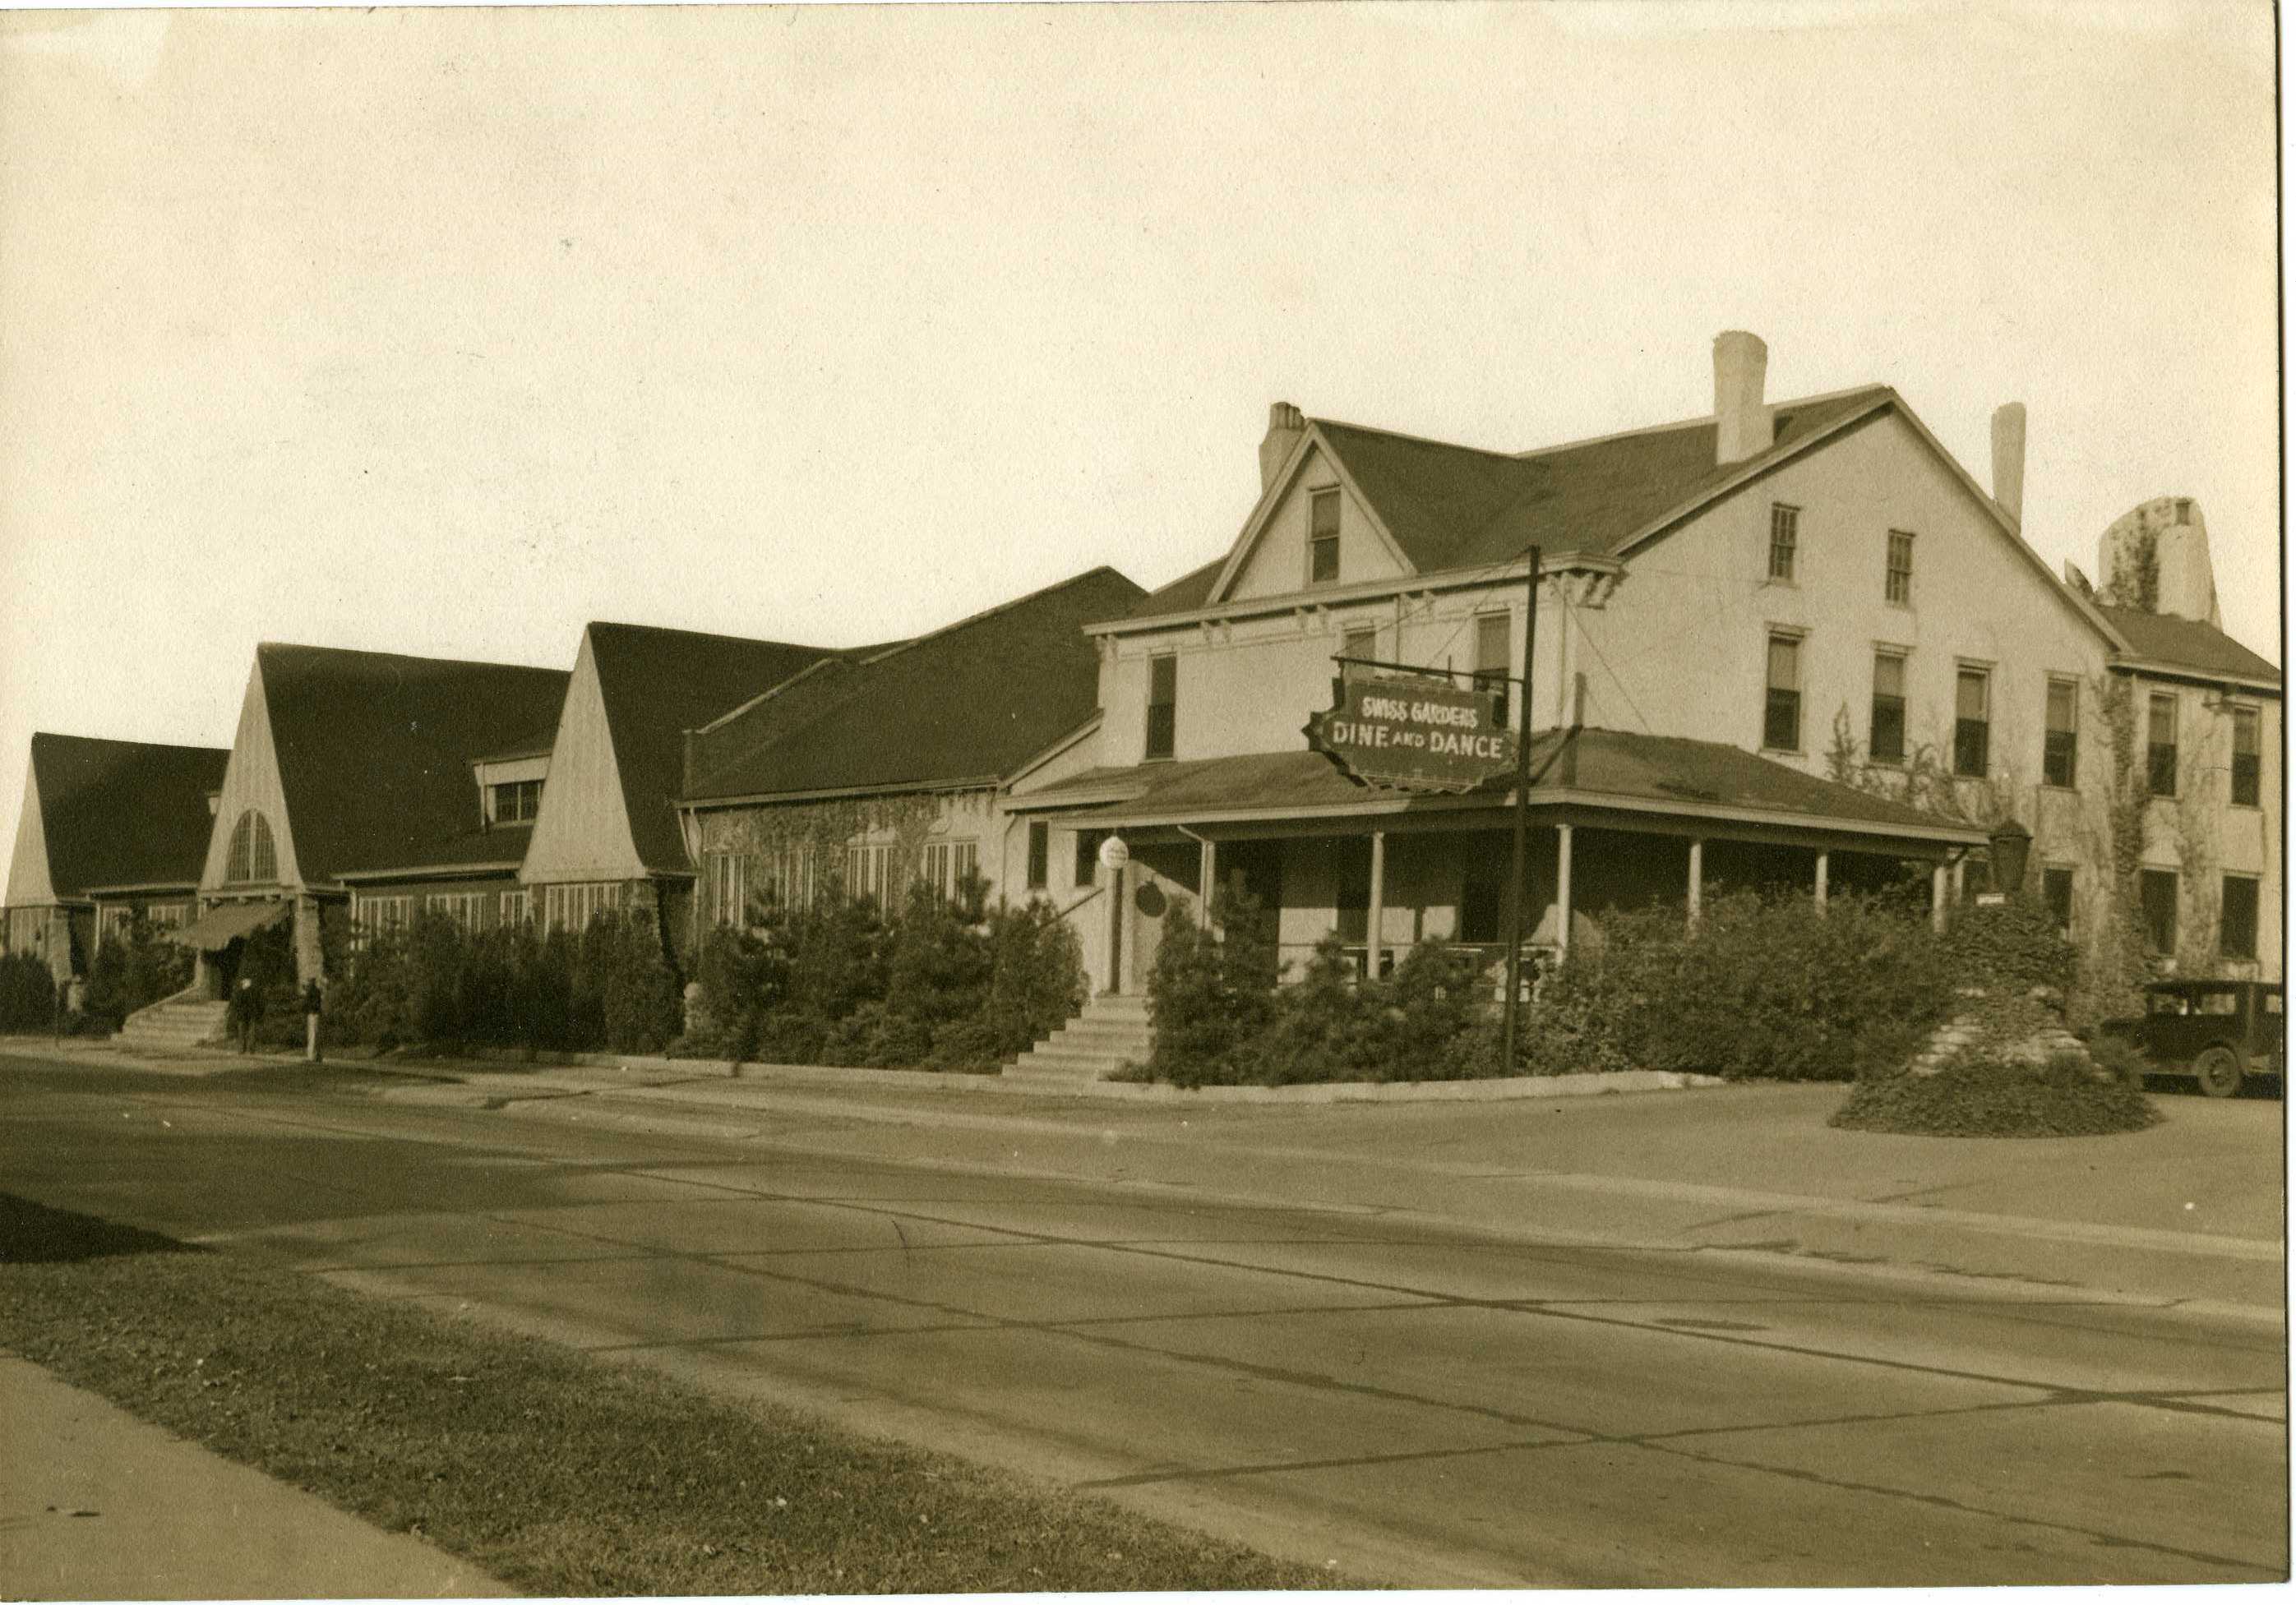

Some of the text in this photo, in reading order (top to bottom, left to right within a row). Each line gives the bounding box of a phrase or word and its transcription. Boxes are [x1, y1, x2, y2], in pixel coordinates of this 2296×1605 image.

[1362, 697, 1478, 728] SWISS GARDENS
[1333, 722, 1503, 759] DINE AND DANCE
